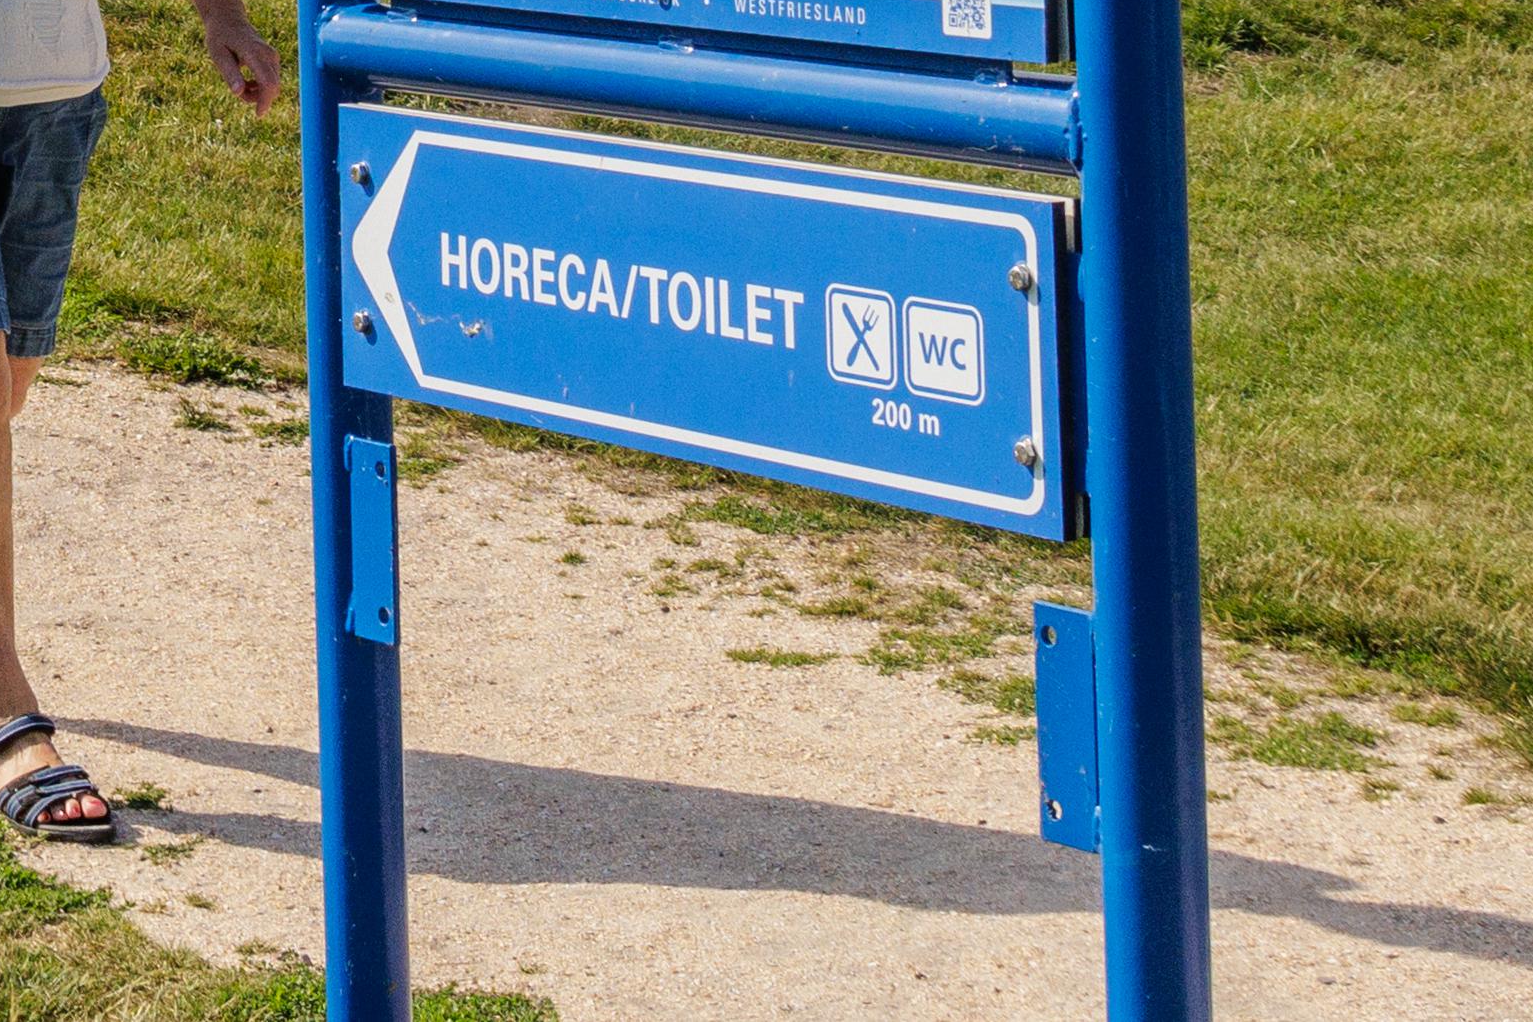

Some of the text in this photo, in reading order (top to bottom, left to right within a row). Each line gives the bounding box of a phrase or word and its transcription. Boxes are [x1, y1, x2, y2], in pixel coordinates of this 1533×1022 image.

[439, 231, 805, 349] HORECA/TOILET
[919, 332, 968, 372] WC
[871, 397, 941, 436] 200 m
